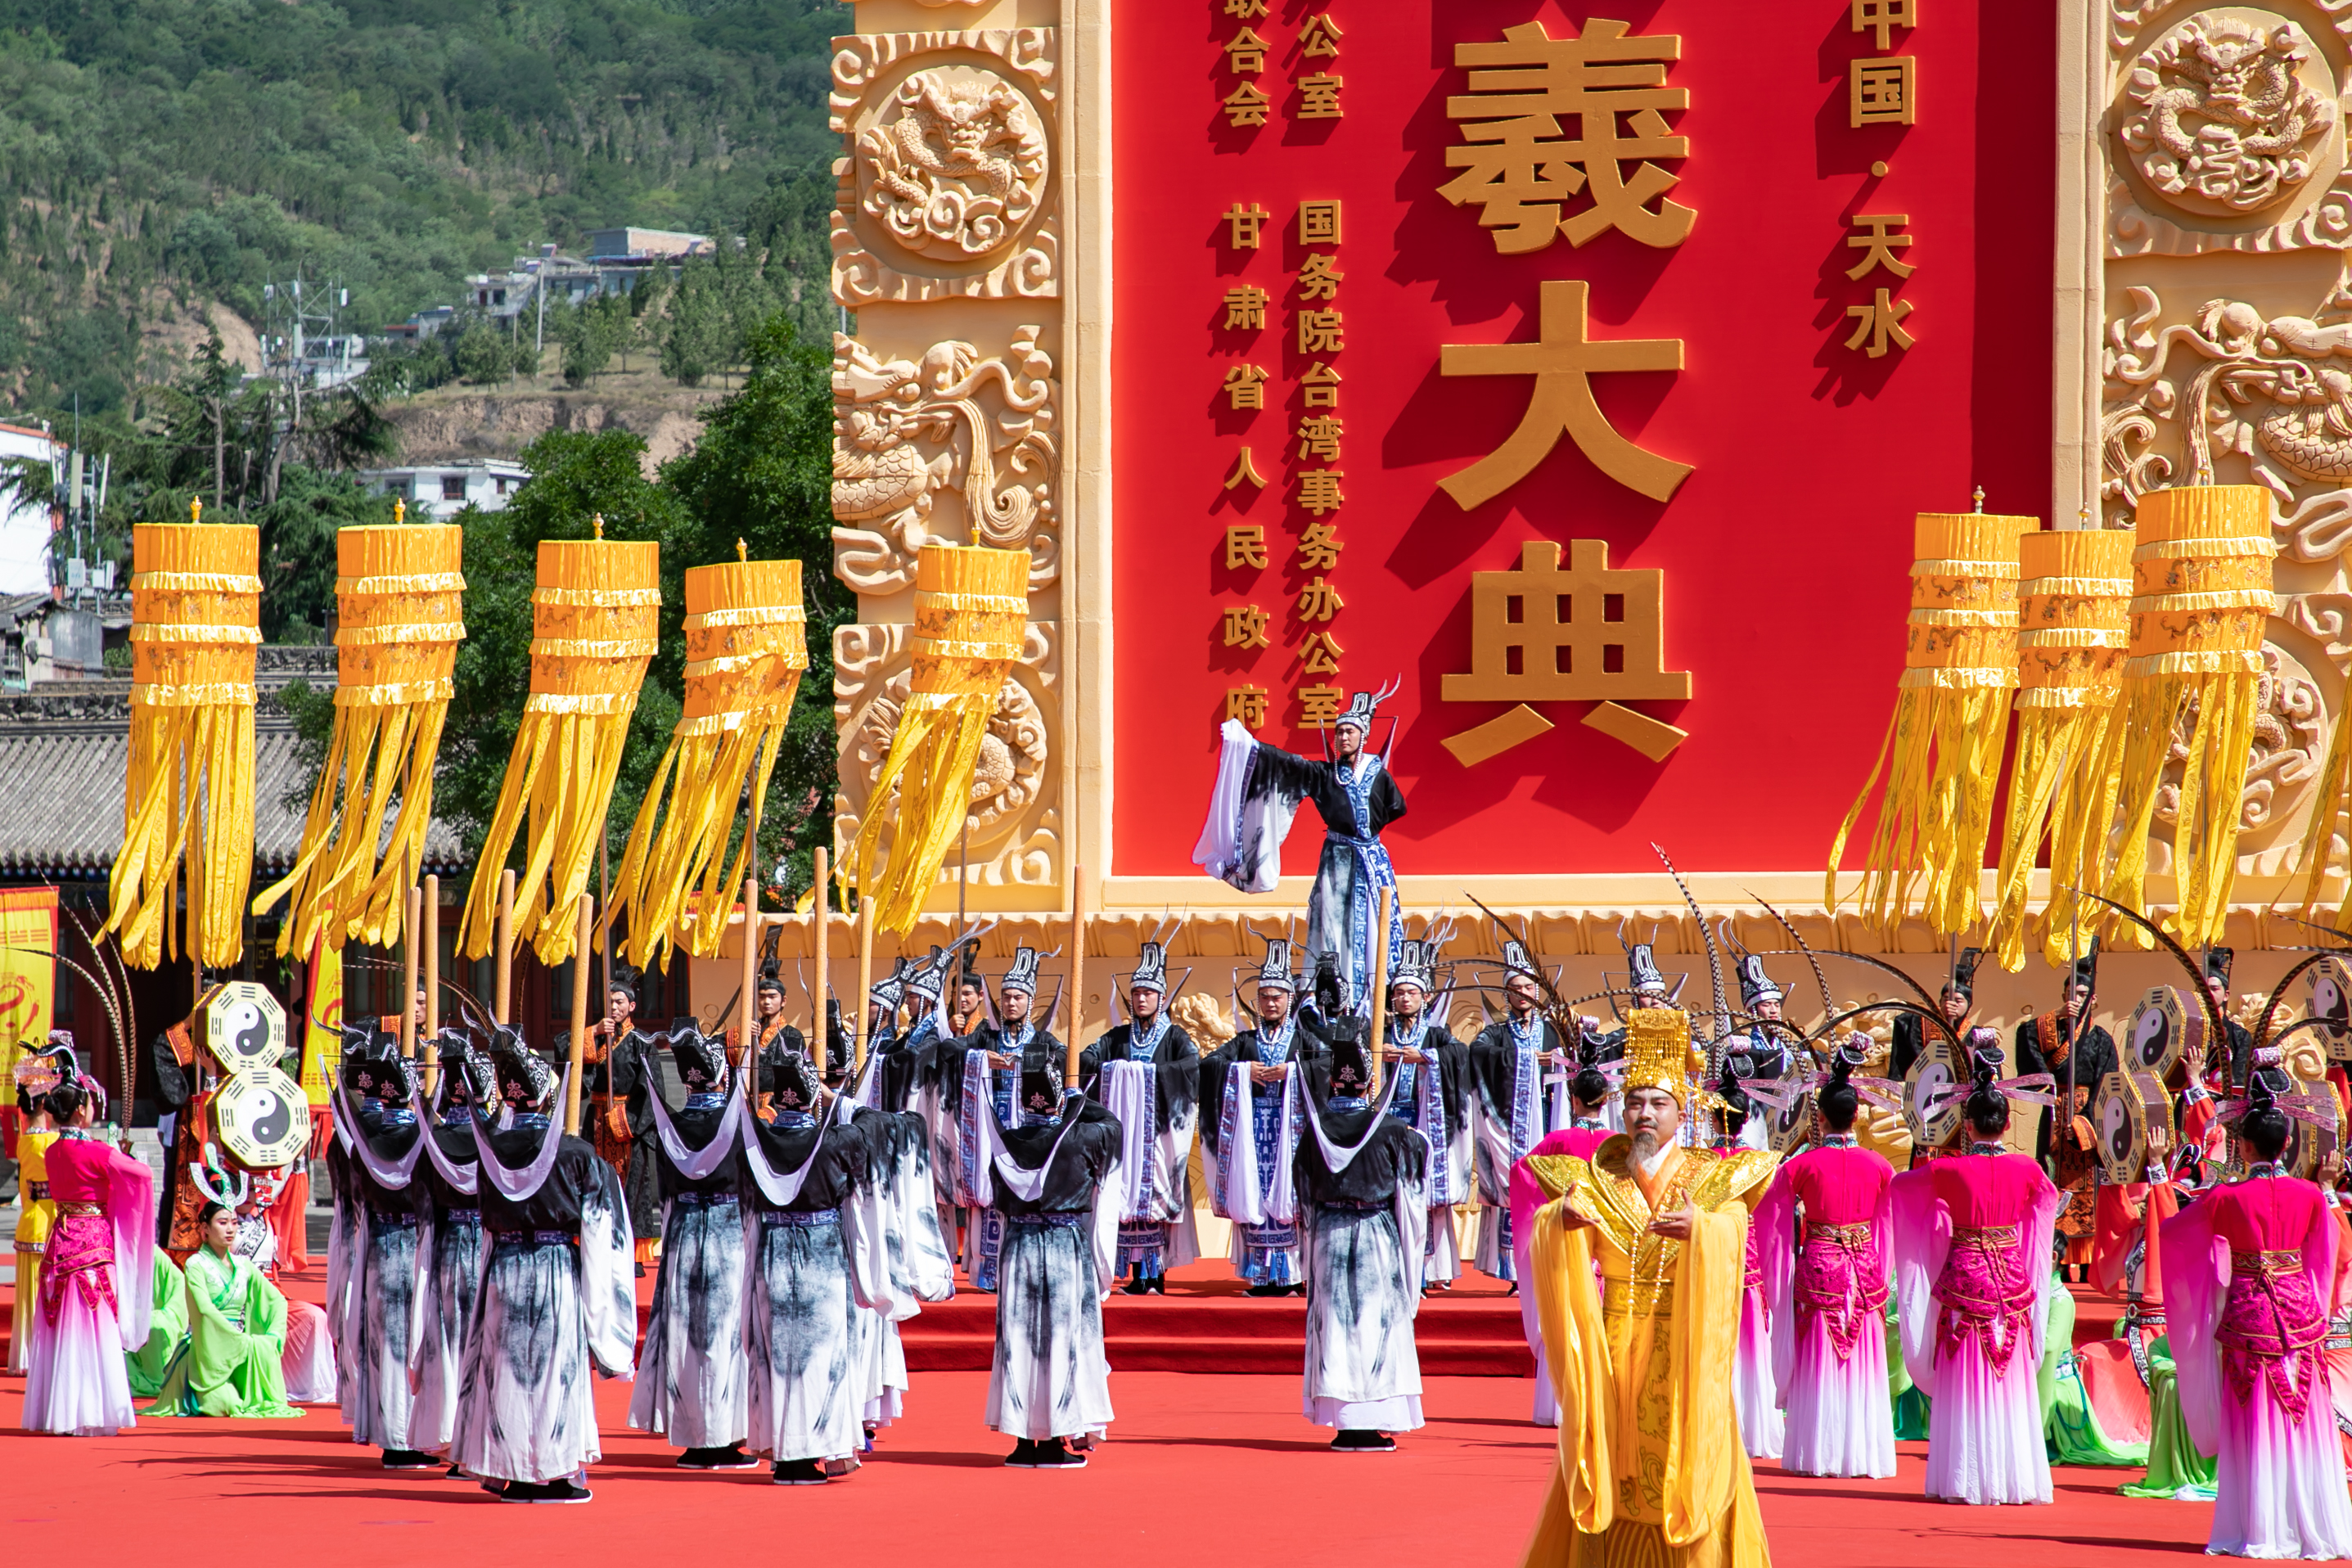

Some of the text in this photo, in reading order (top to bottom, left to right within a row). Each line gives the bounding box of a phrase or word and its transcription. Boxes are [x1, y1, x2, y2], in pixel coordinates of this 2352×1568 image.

[1223, 202, 1271, 730] 甘肃省人民政府
[1297, 13, 1345, 729] 公室 国务院台湾事务办公室
[1435, 17, 1699, 768] 羲大典
